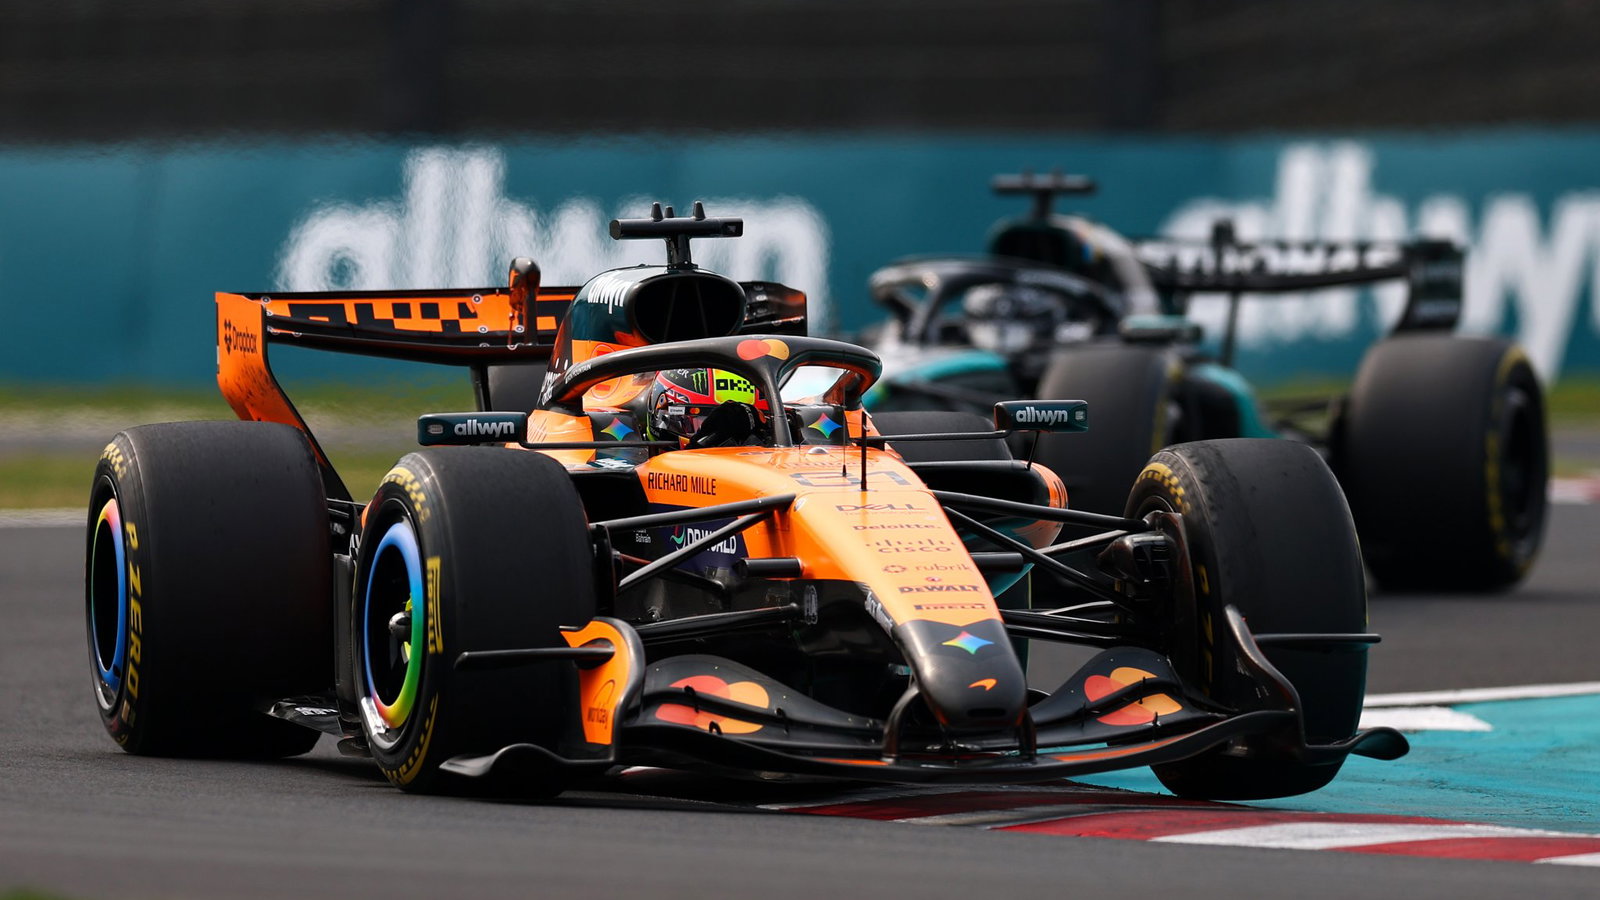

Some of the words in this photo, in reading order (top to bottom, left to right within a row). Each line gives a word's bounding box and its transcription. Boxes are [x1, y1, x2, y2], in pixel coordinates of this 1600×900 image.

[233, 325, 257, 358] Dropbox
[715, 378, 755, 394] OKX
[1016, 406, 1068, 426] allwyn
[454, 419, 515, 438] allwyn
[648, 472, 688, 493] RICHARD
[691, 476, 717, 496] MILLE
[835, 503, 928, 512] DELL
[126, 521, 139, 551] P
[914, 563, 973, 572] rubrik
[426, 556, 443, 655] PIRELLI
[126, 561, 142, 699] ZERO
